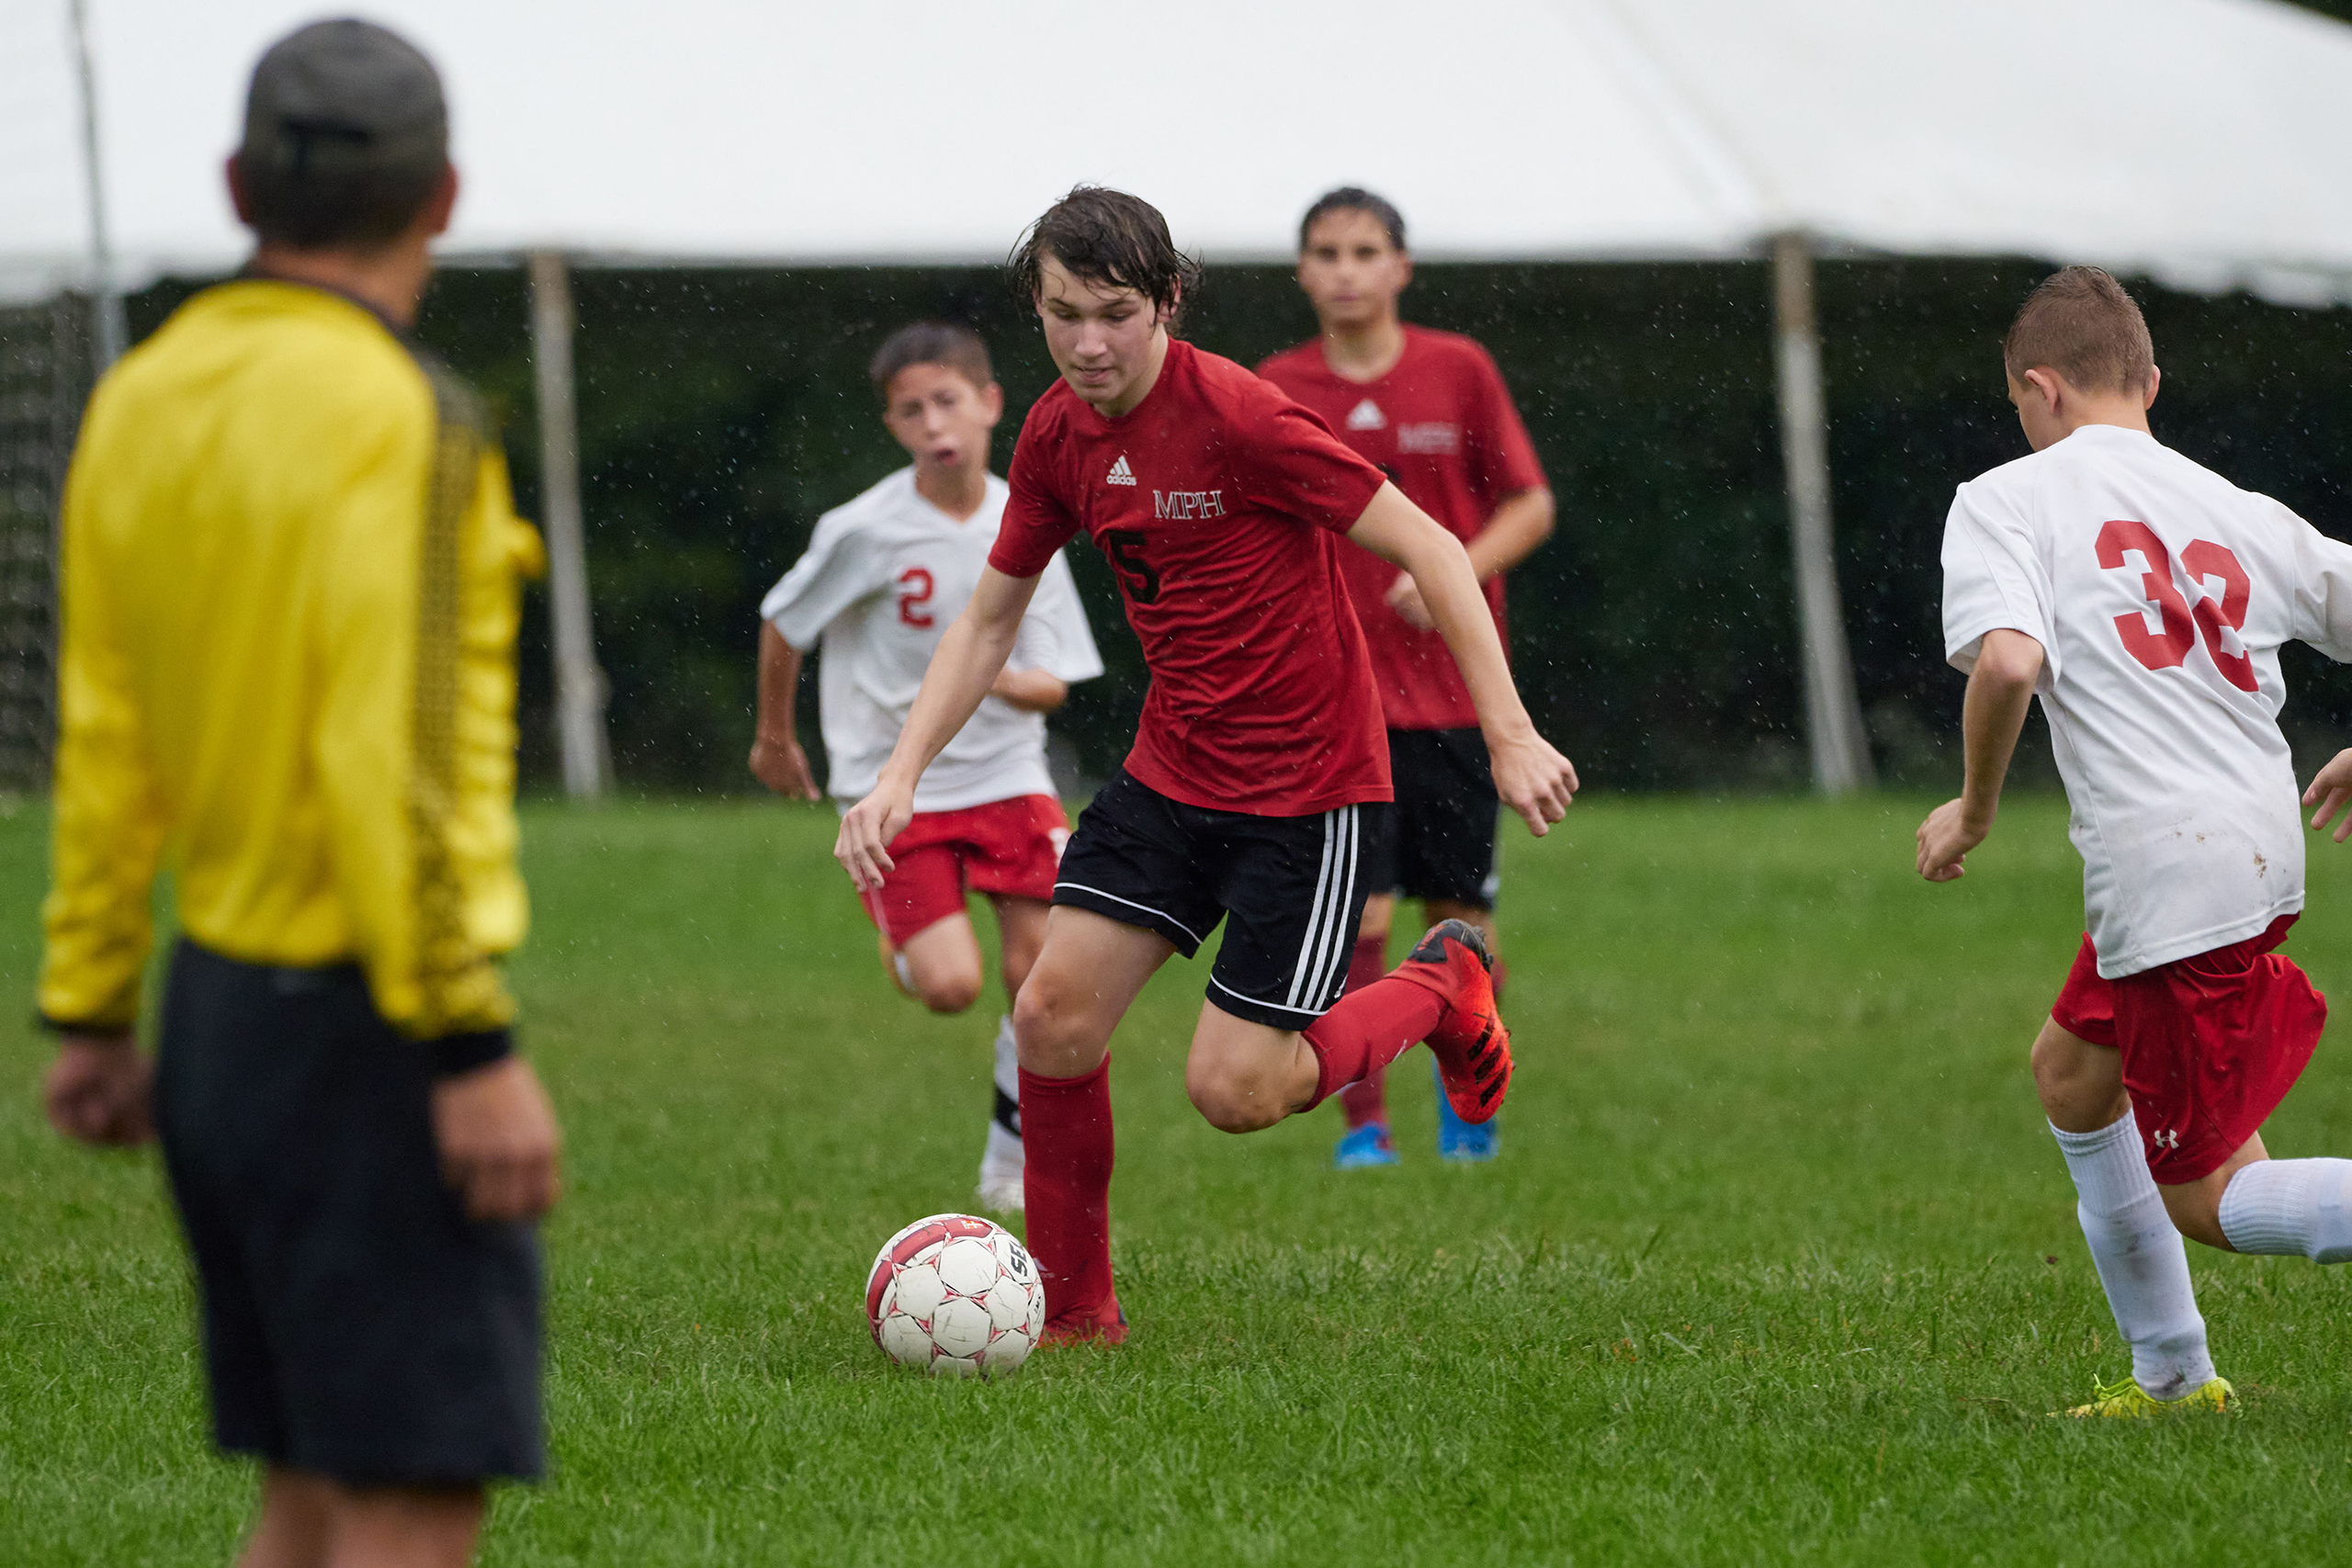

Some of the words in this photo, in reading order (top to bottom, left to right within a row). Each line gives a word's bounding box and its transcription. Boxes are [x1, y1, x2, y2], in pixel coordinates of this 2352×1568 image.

[1106, 474, 1137, 486] adidas
[1152, 490, 1227, 520] MPH
[1107, 530, 1159, 604] 5
[899, 569, 934, 626] 2
[2095, 520, 2260, 693] 32
